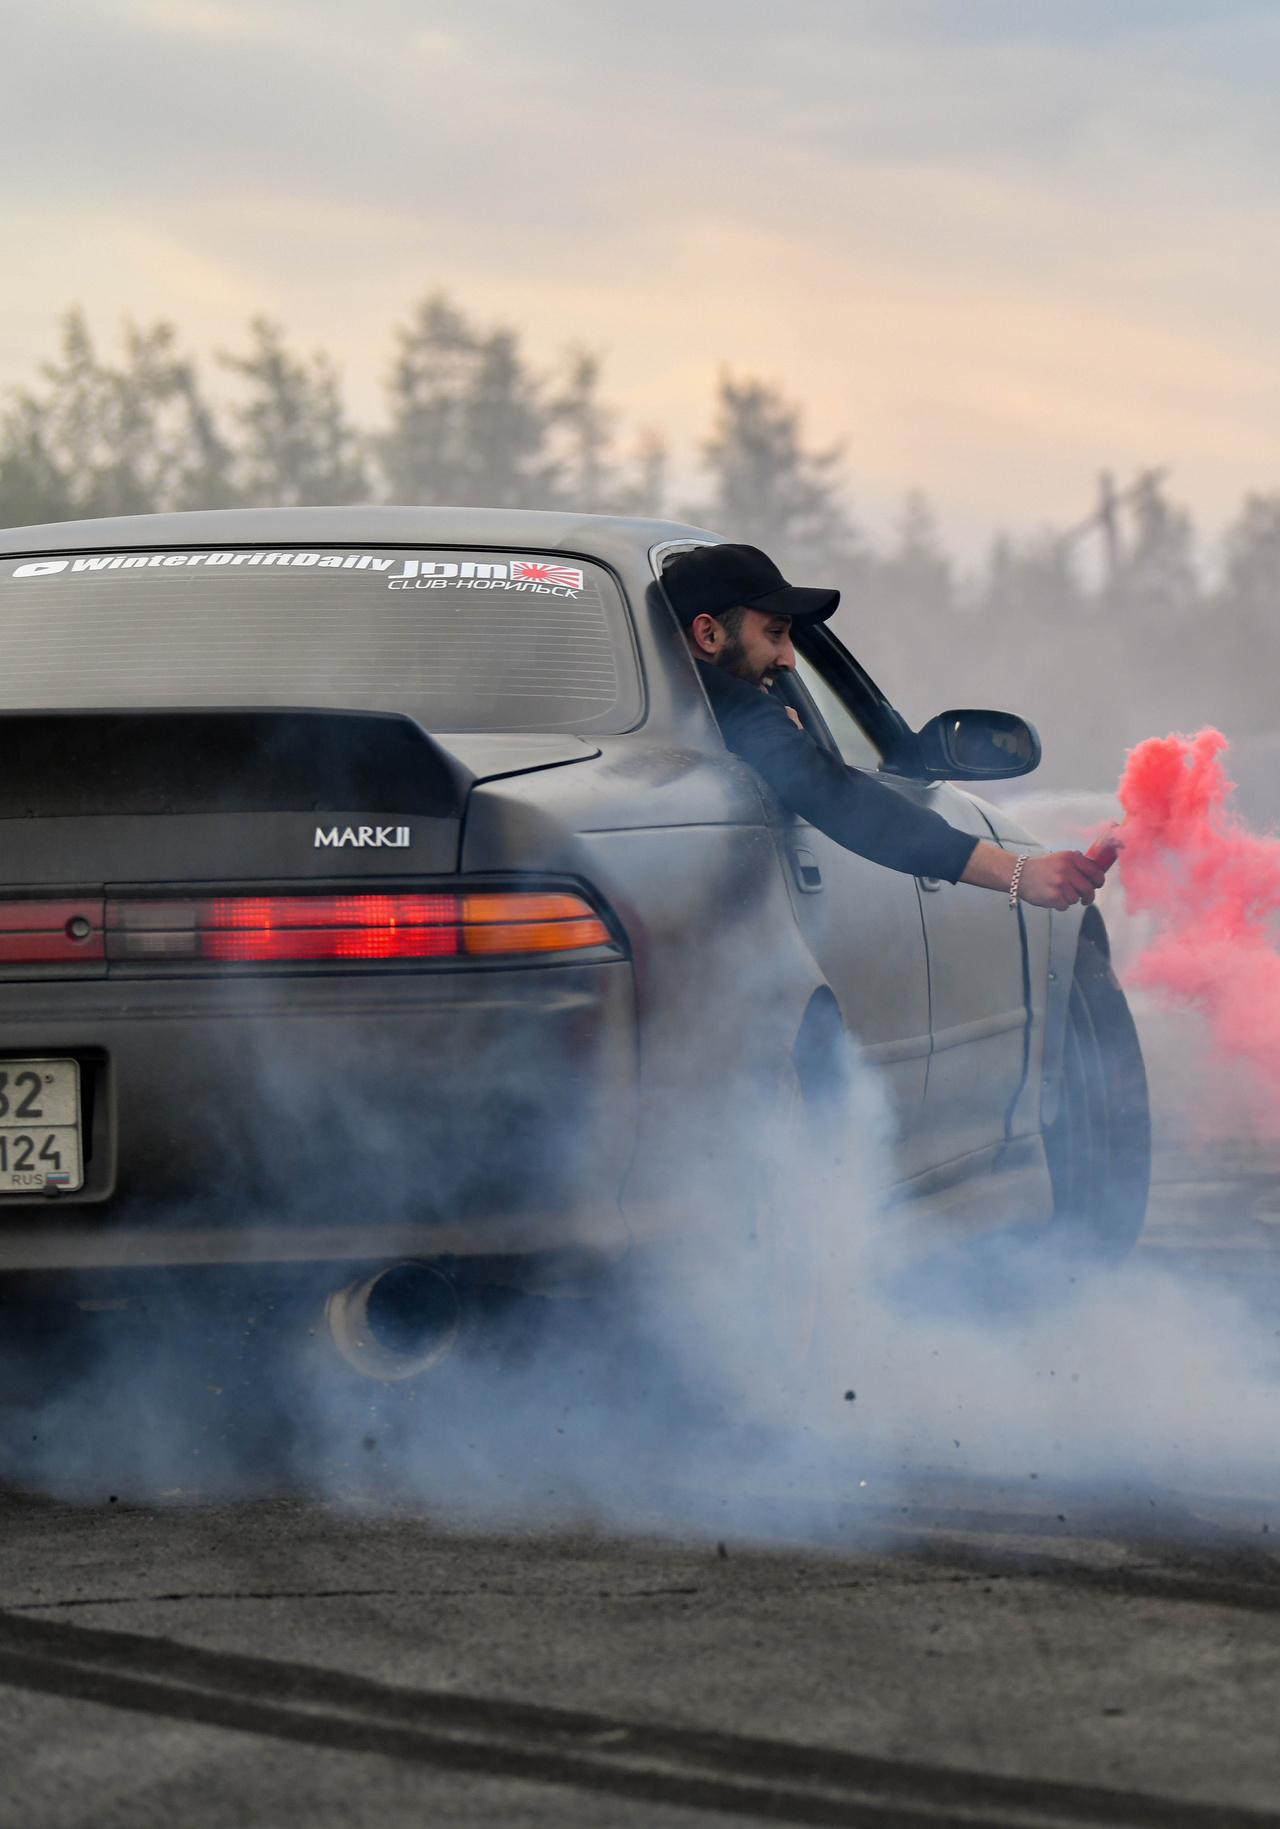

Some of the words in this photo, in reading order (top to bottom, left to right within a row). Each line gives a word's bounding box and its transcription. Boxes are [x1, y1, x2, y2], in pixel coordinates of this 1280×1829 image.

[71, 553, 395, 572] WinterDriftDaily
[0, 1134, 60, 1171] 124
[12, 1174, 43, 1185] RUS
